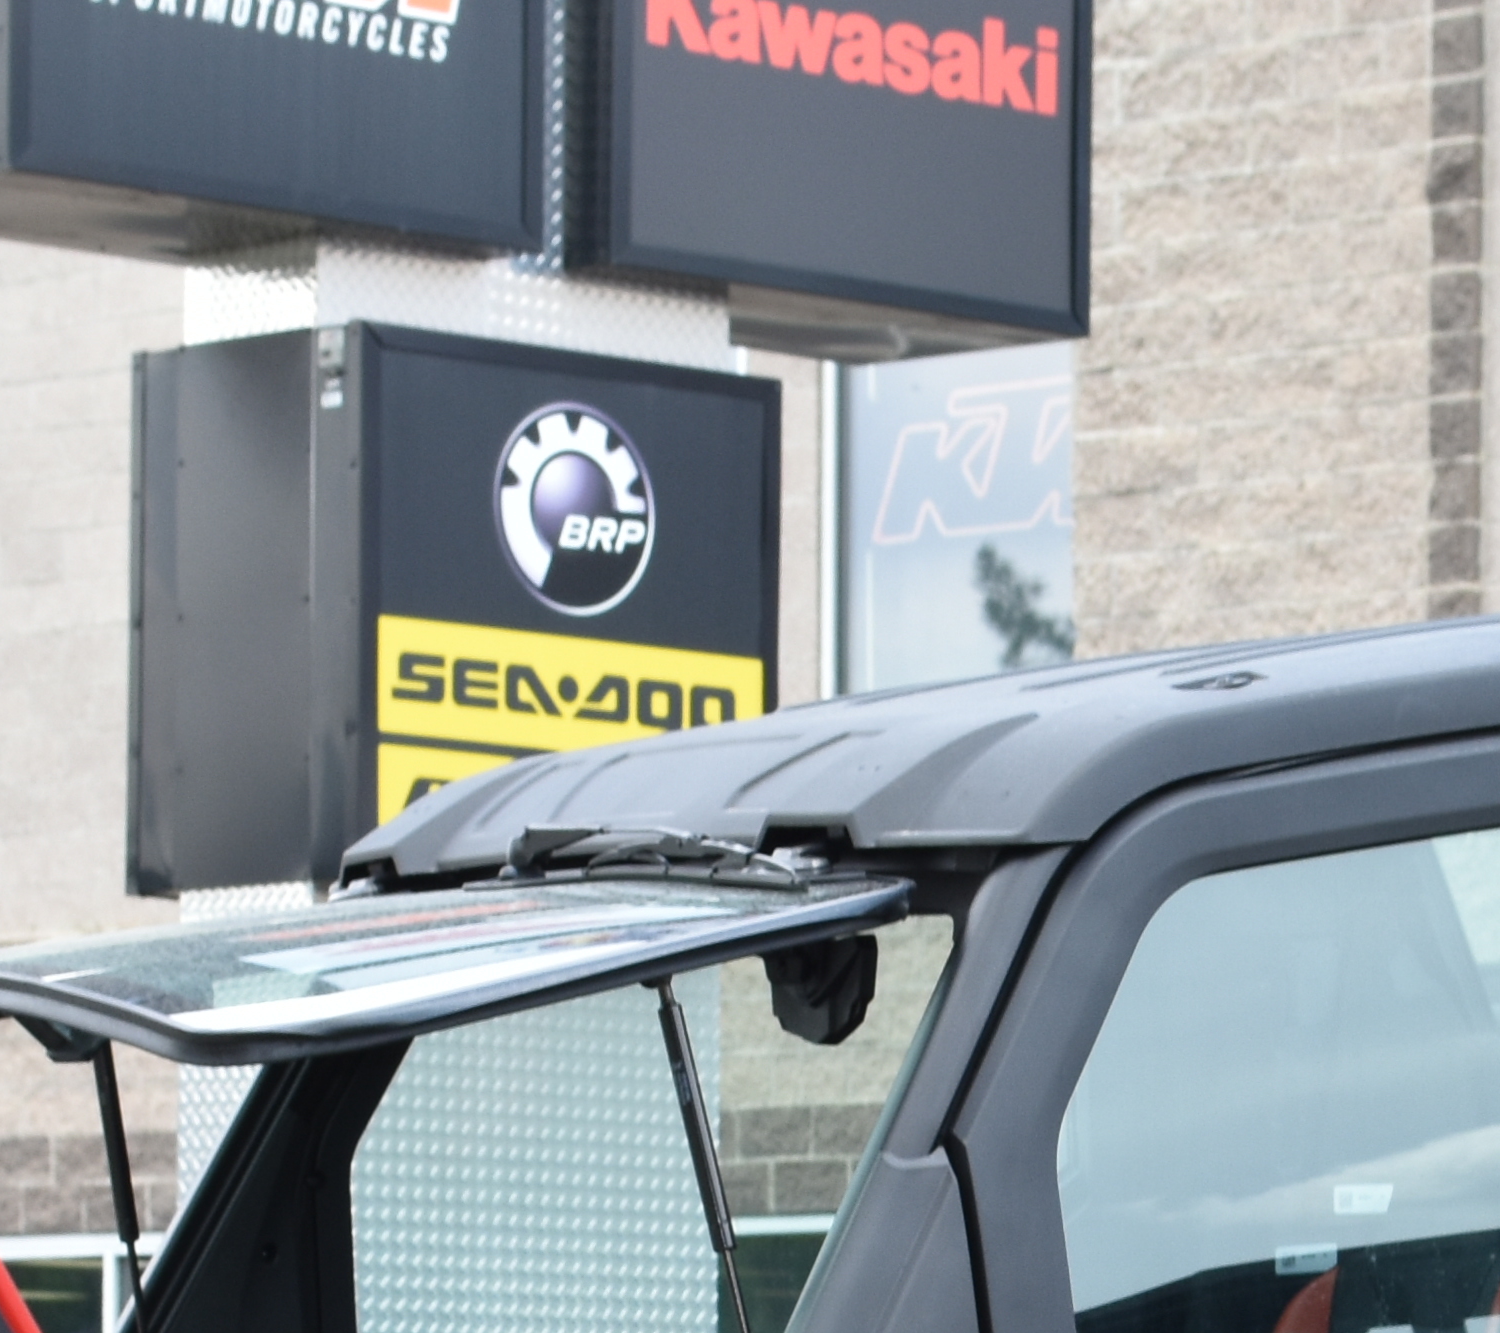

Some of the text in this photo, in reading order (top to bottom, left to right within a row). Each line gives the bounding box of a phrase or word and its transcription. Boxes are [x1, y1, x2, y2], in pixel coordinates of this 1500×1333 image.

[646, 0, 1059, 116] Kawasaki
[871, 374, 1076, 545] KT
[557, 513, 646, 555] BRP
